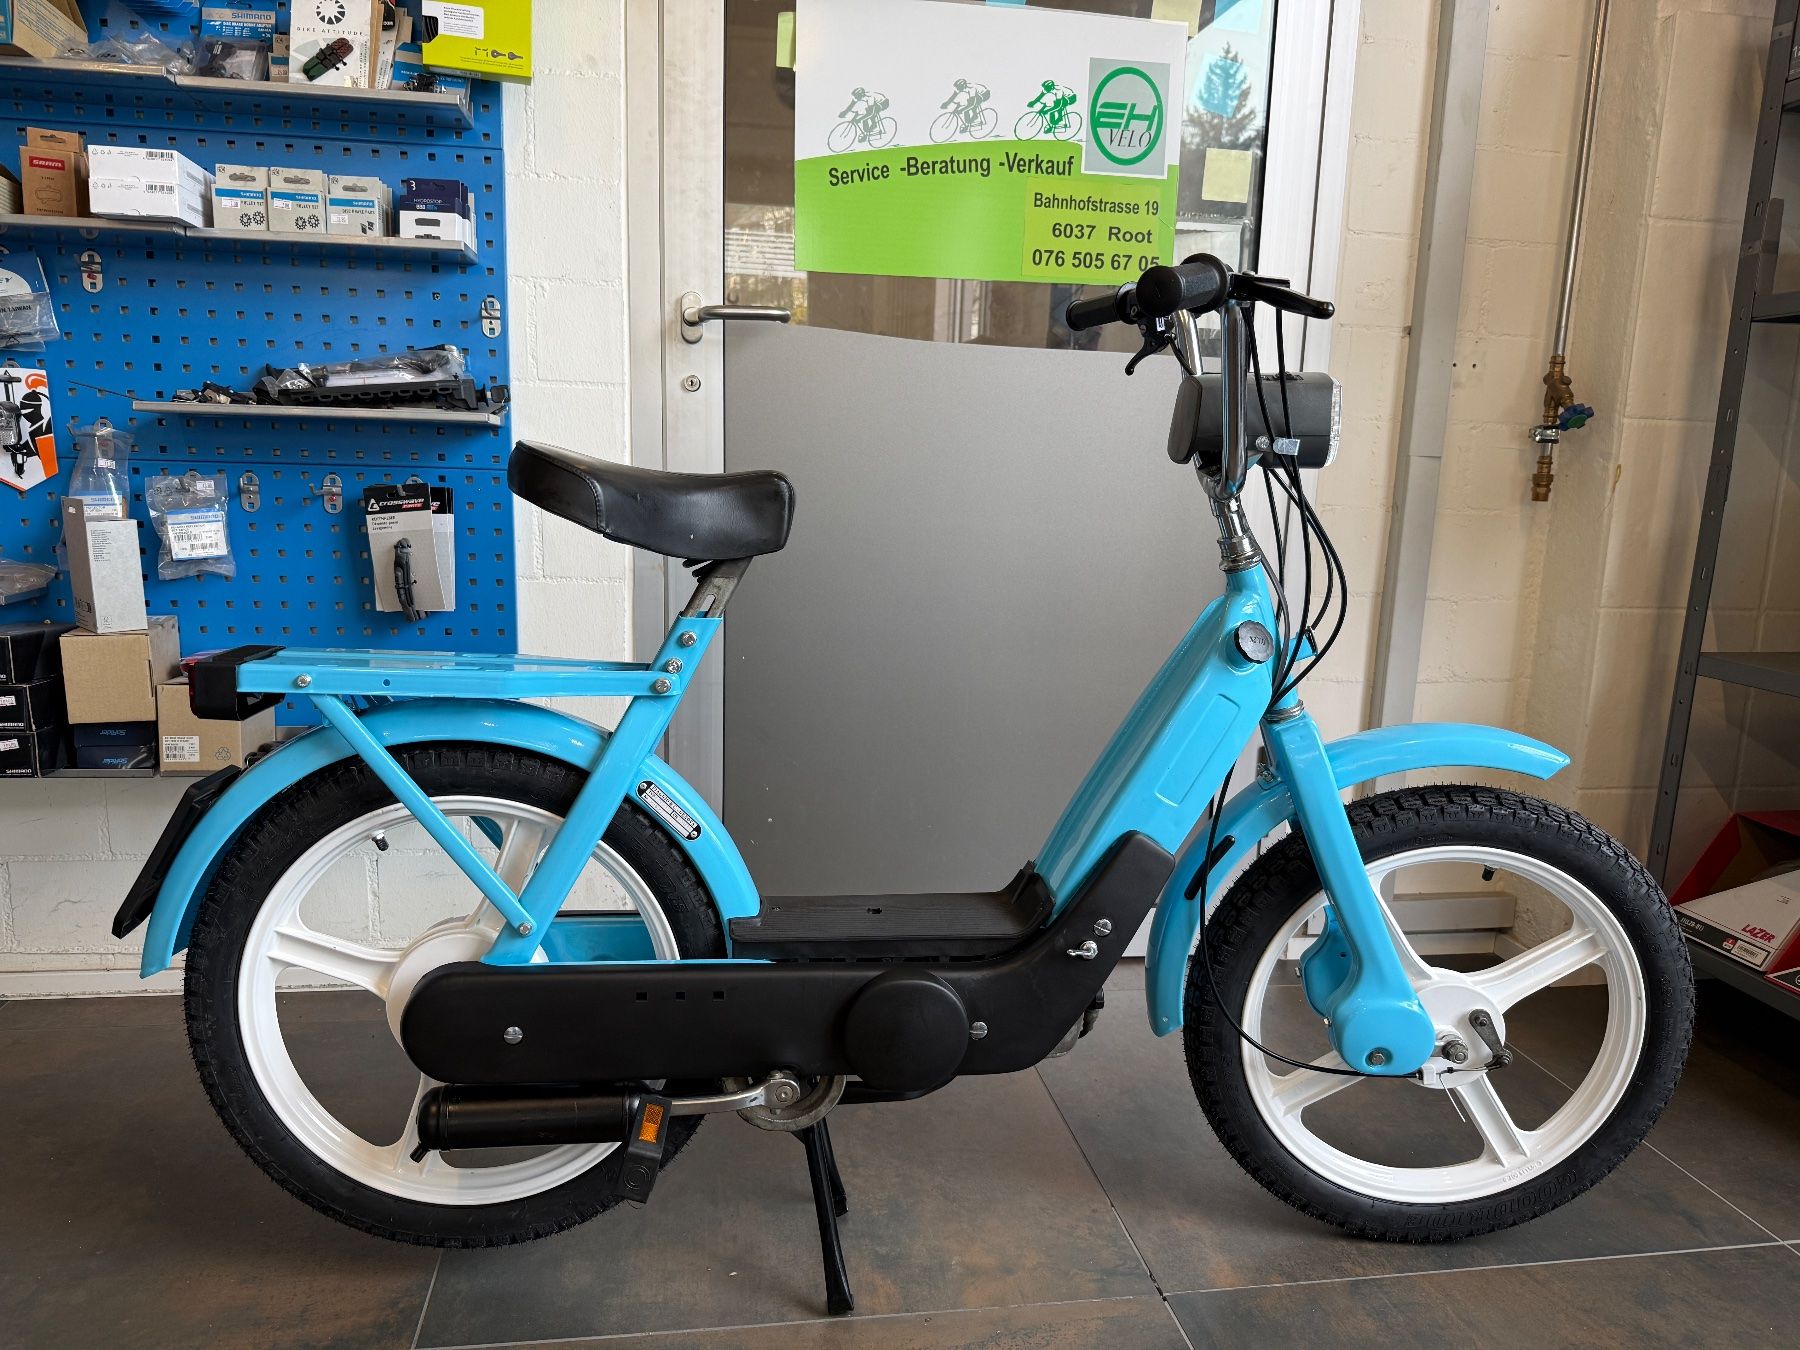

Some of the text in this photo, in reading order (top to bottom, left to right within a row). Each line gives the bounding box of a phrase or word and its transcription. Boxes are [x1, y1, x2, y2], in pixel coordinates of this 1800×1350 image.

[231, 12, 272, 20] SHIMANO
[1109, 128, 1152, 148] VELO
[32, 159, 63, 167] SRAM
[828, 162, 890, 187] Service
[1034, 192, 1159, 215] Bahnhofstrasse 19
[1052, 222, 1153, 243] 6037 Root
[1032, 249, 1065, 267] 076
[1072, 251, 1105, 269] 505
[1111, 253, 1133, 271] 67
[1741, 923, 1776, 943] LAZER
